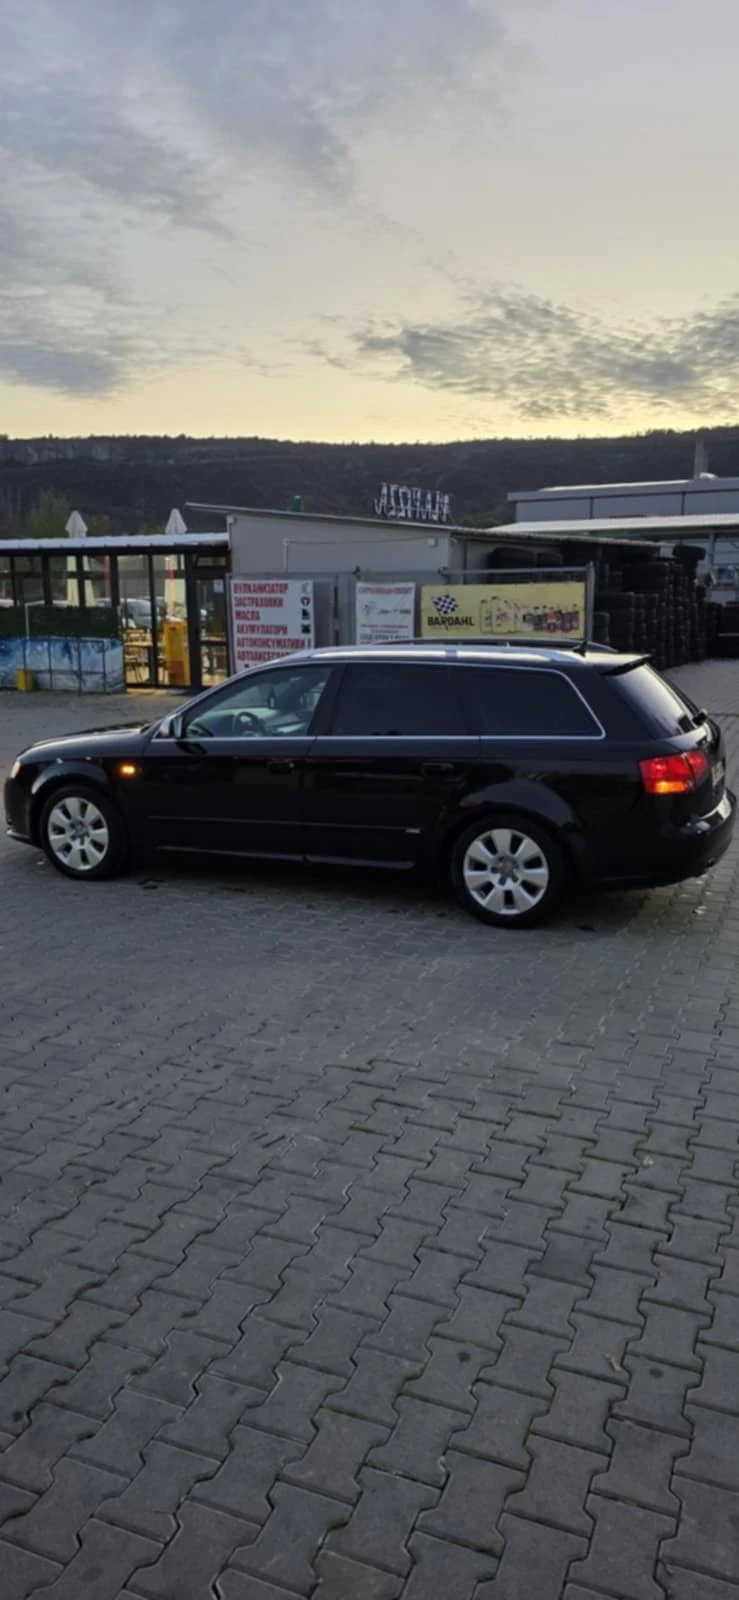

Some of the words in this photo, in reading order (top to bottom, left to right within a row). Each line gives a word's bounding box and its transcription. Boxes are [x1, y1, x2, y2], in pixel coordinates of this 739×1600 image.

[233, 583, 288, 594] ВУЛКАНИЗАТОР
[234, 597, 284, 608] ЗАСТРАХОВКИ
[235, 610, 261, 621] МАСЛА
[427, 616, 475, 626] BARDAHL
[237, 624, 288, 635] АКУМУЛАТОРИ
